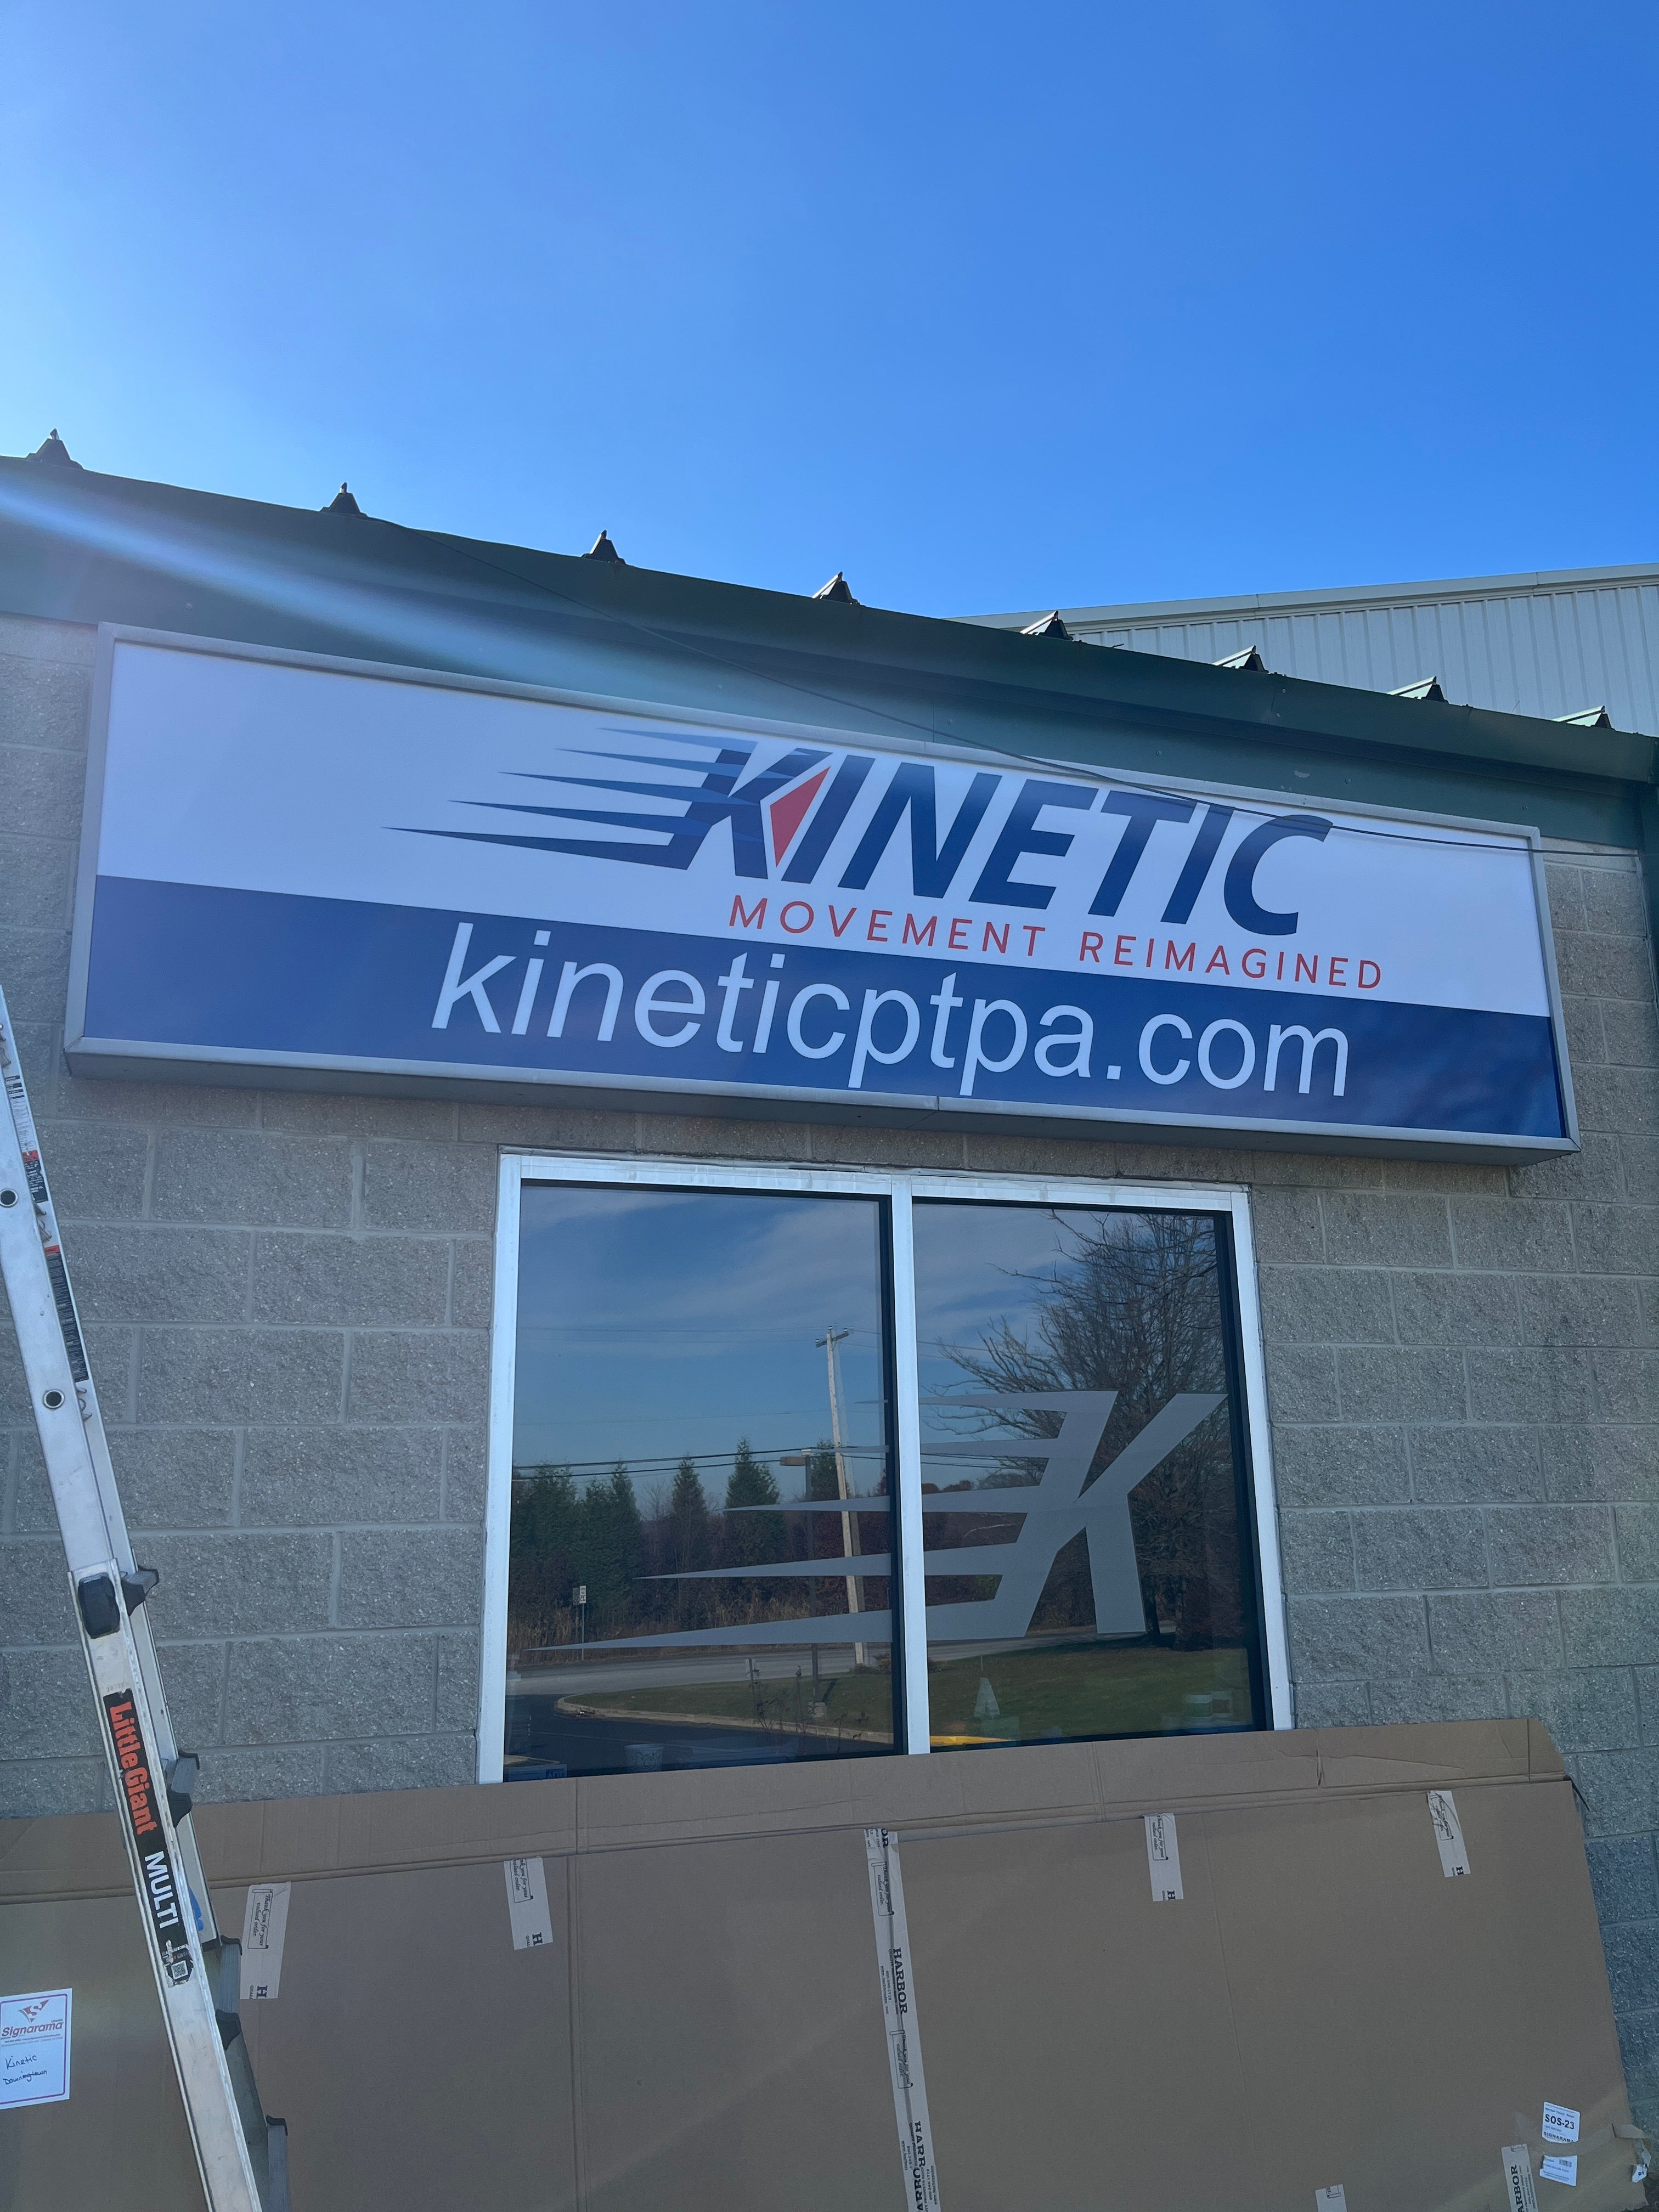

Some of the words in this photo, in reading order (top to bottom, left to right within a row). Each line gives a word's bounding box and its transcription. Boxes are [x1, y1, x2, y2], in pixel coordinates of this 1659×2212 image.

[667, 741, 1334, 936] KINETIC
[729, 894, 1046, 957] MOVEMENT
[1079, 930, 1382, 989] REIMAGINED
[431, 922, 1350, 1097] kineticptpa.com
[144, 1850, 179, 1929] MULTI
[893, 1948, 908, 2015] HARBOR
[2, 2022, 63, 2038] Signarama
[5, 2055, 38, 2070] Kinetic
[1544, 2114, 1575, 2130] SOS-23
